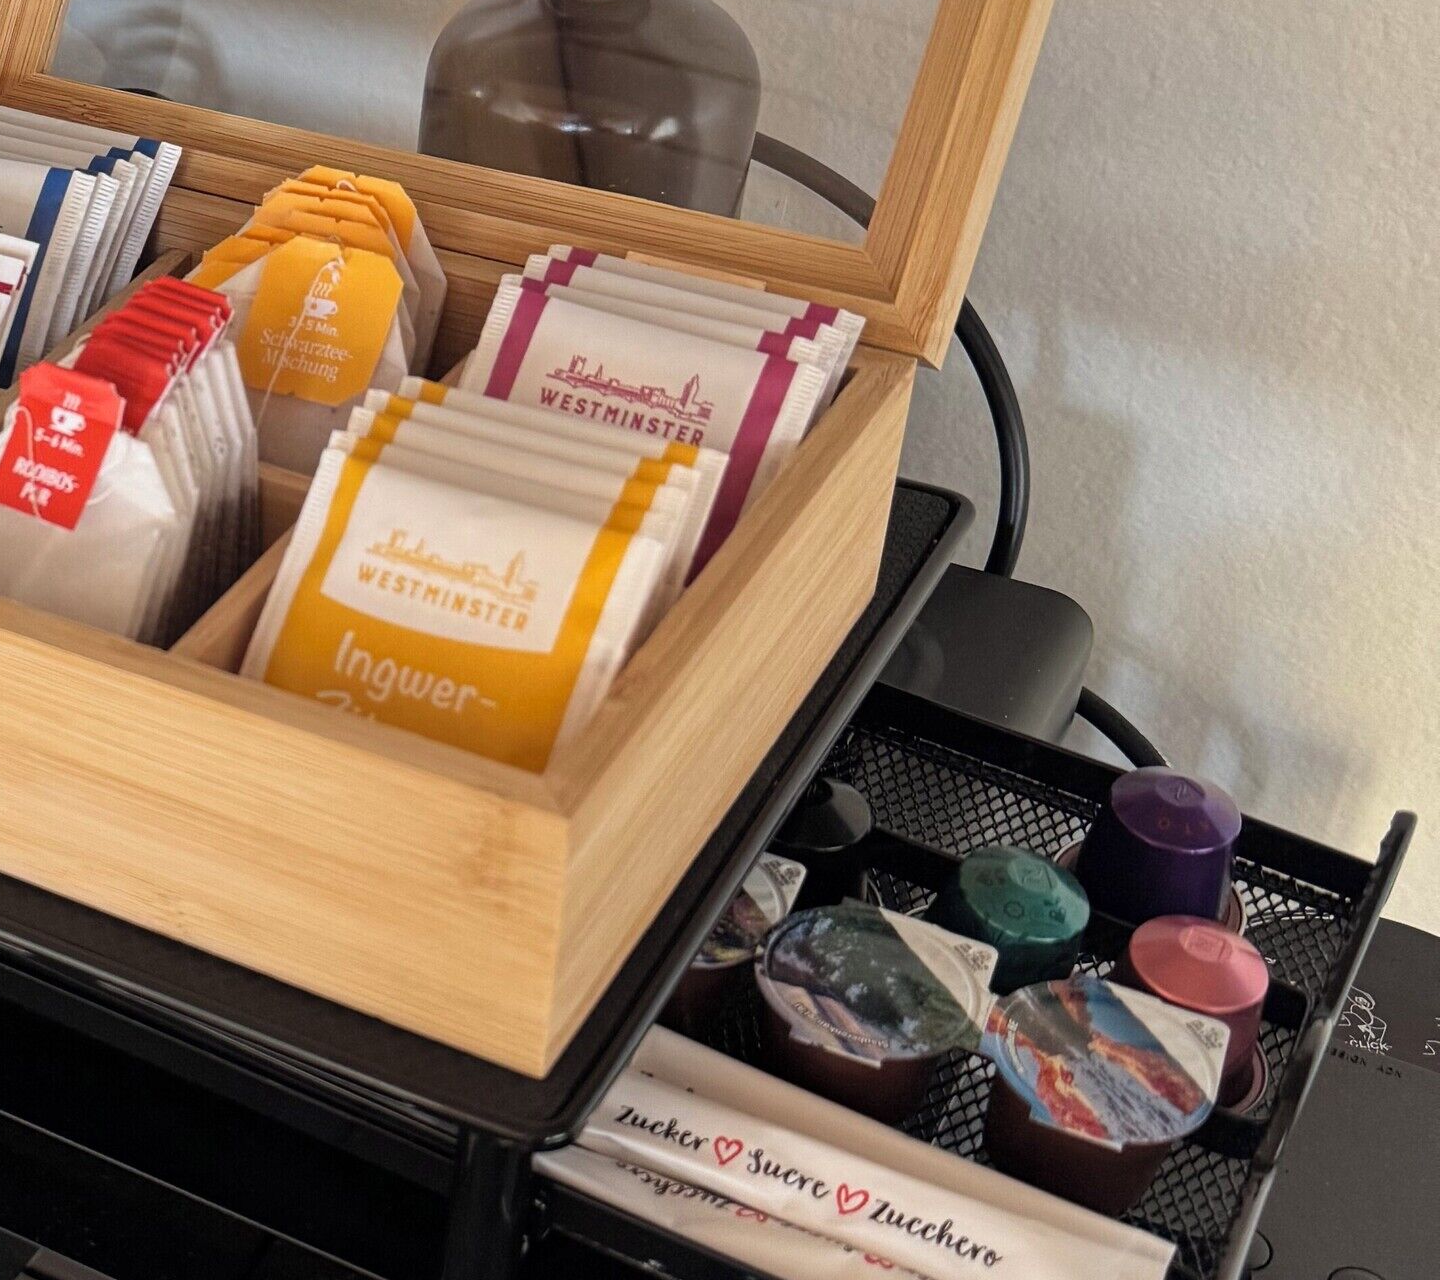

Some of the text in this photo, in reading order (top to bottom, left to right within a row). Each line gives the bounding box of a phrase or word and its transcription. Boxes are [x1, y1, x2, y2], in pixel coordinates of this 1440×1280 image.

[540, 387, 704, 446] WESTMINSTER
[358, 564, 529, 632] WESTMINSTER
[335, 630, 497, 713] Ingwer-
[616, 1104, 709, 1151] Zucker
[746, 1148, 830, 1199] Sucre
[868, 1198, 1003, 1268] Zucchero
